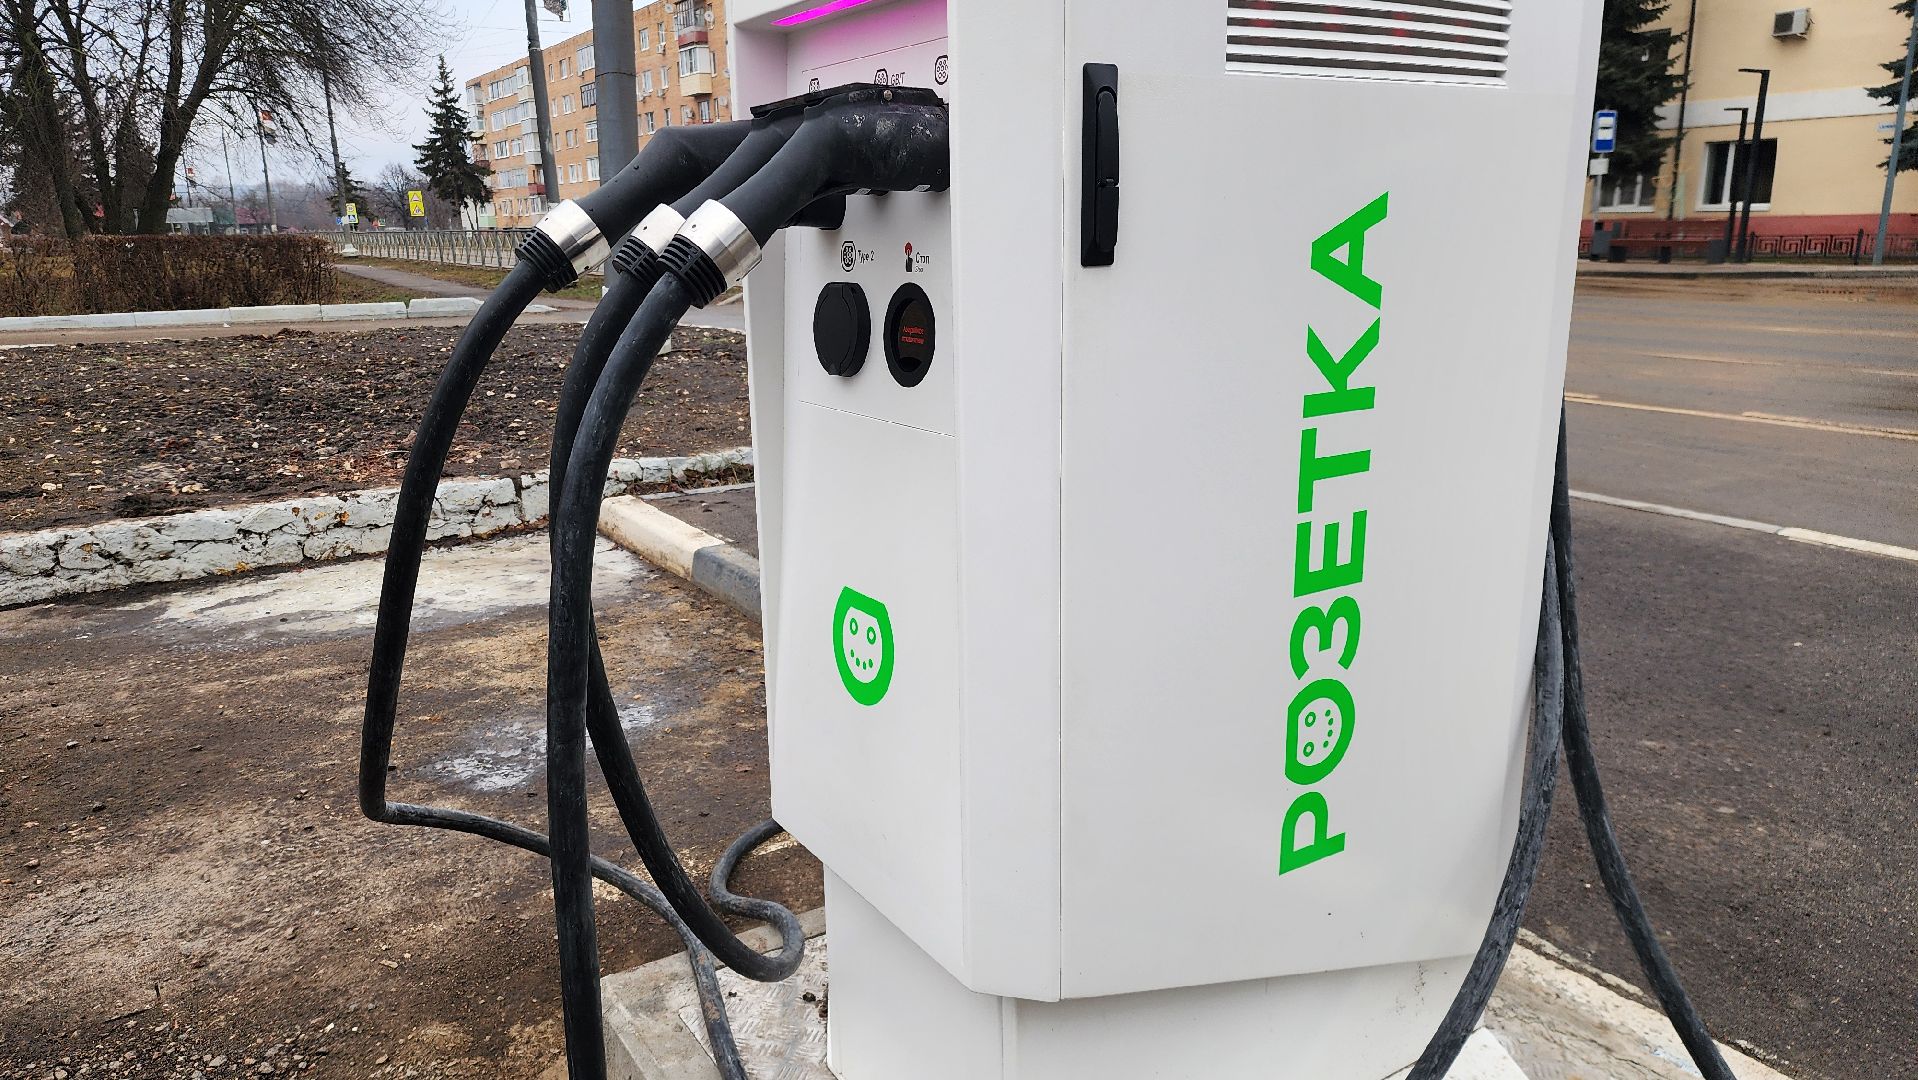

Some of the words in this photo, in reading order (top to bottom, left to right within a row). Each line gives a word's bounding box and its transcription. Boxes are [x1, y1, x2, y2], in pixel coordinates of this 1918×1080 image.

[857, 249, 870, 264] Type
[870, 250, 875, 262] 2
[915, 251, 930, 265] Стоп
[1279, 191, 1389, 876] РОЗЕТКА
